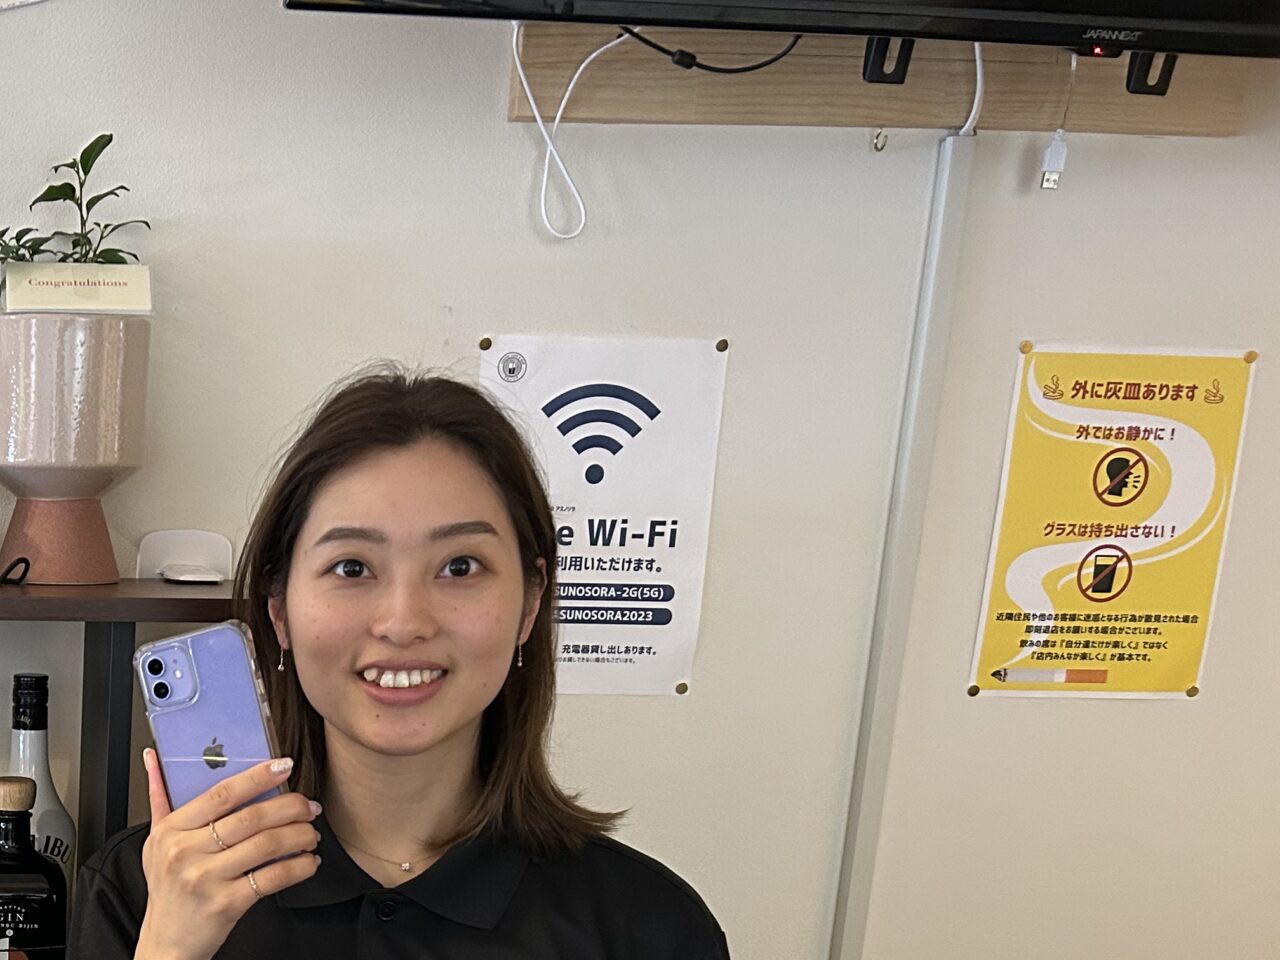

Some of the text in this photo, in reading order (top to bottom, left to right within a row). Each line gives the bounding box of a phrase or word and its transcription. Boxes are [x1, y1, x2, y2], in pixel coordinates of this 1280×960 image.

[1083, 28, 1143, 41] JAPANNEXT
[28, 277, 128, 288] Congratulations
[1071, 380, 1198, 401] 外に灰皿あります
[1076, 424, 1176, 440] 外ではお静かに！
[588, 519, 678, 548] Wi-Fi
[1044, 523, 1176, 538] グラスは持ち出さない！
[562, 645, 656, 655] 充電器貸し出しあります。
